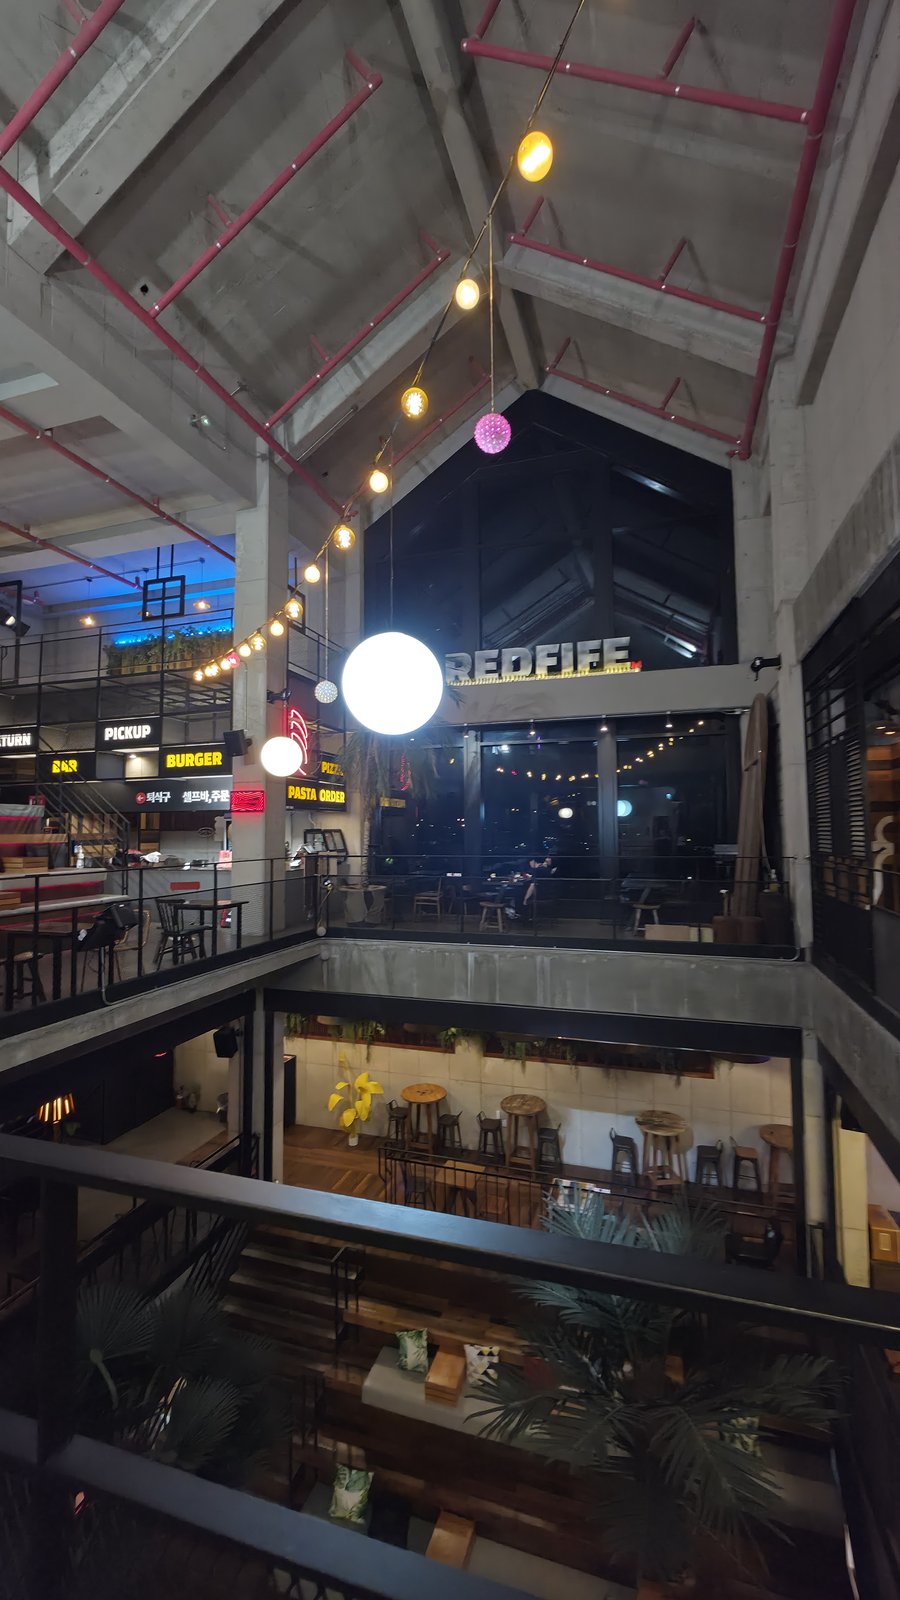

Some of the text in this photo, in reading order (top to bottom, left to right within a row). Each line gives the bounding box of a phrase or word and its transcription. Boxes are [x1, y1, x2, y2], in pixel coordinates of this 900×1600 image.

[104, 724, 151, 740] PICKUP
[51, 759, 78, 774] BAR
[166, 751, 223, 769] BURGER
[146, 791, 171, 803] 퇴식구
[287, 785, 345, 803] PASTA ORDER
